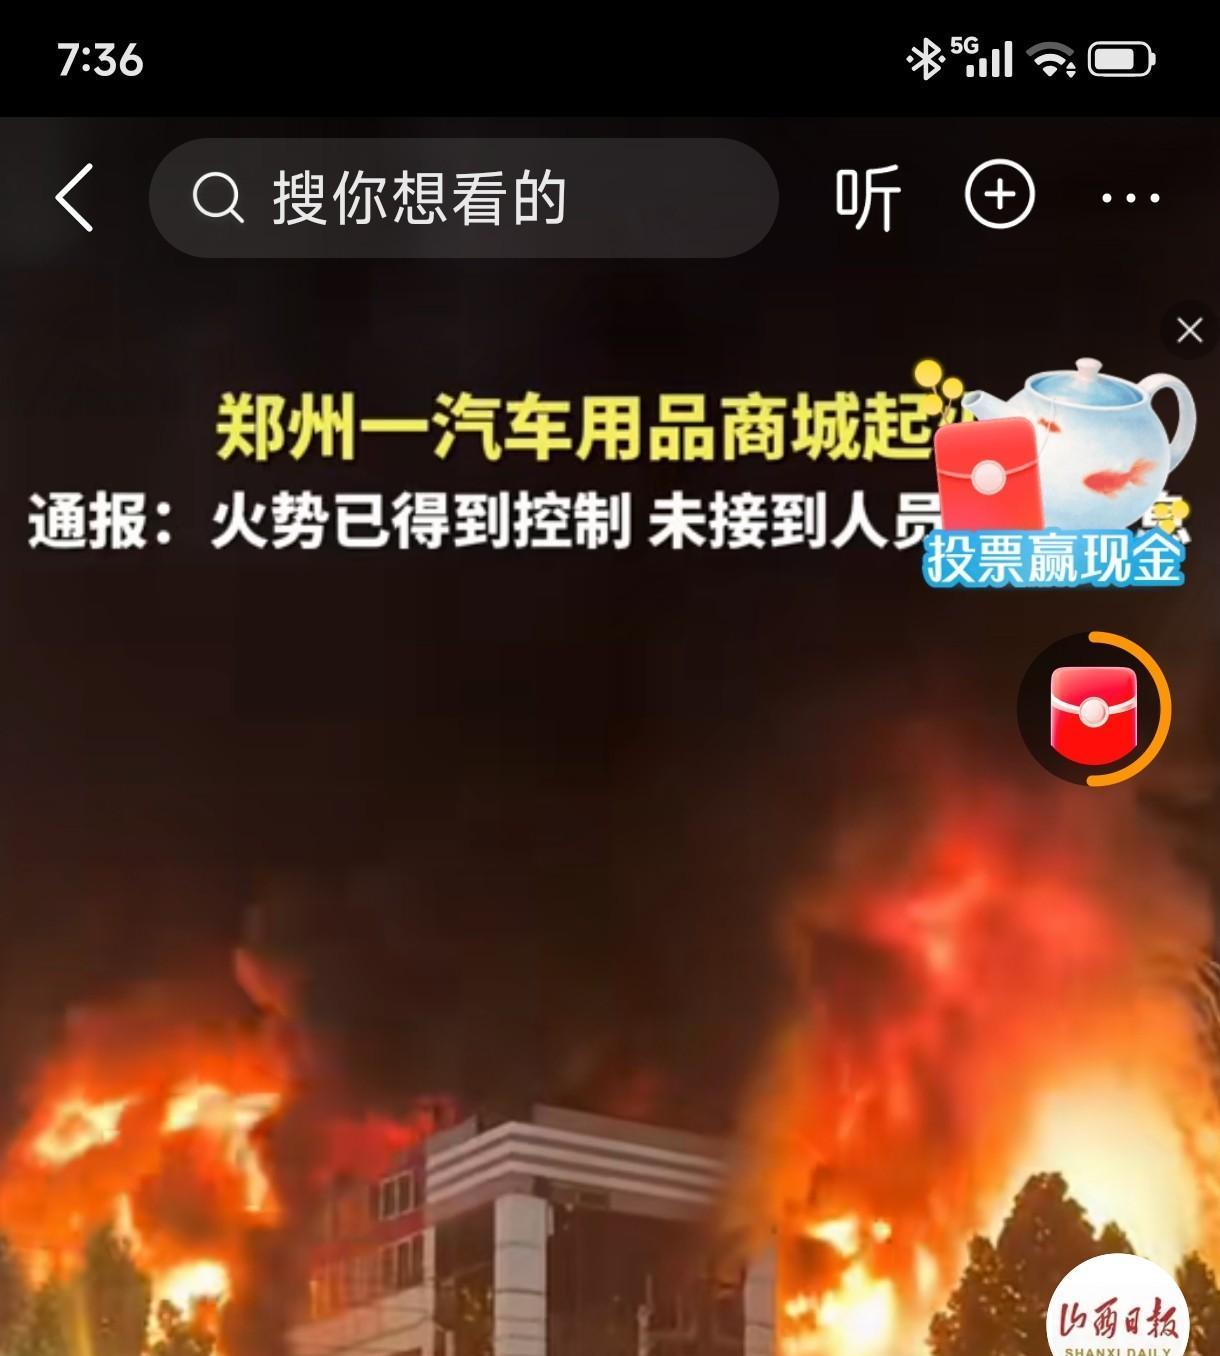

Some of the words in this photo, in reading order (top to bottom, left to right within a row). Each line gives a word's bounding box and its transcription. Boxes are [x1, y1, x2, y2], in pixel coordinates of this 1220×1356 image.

[57, 42, 144, 77] 7:36
[950, 35, 979, 55] 5G
[273, 168, 567, 228] 搜你想看的
[836, 163, 902, 233] 听
